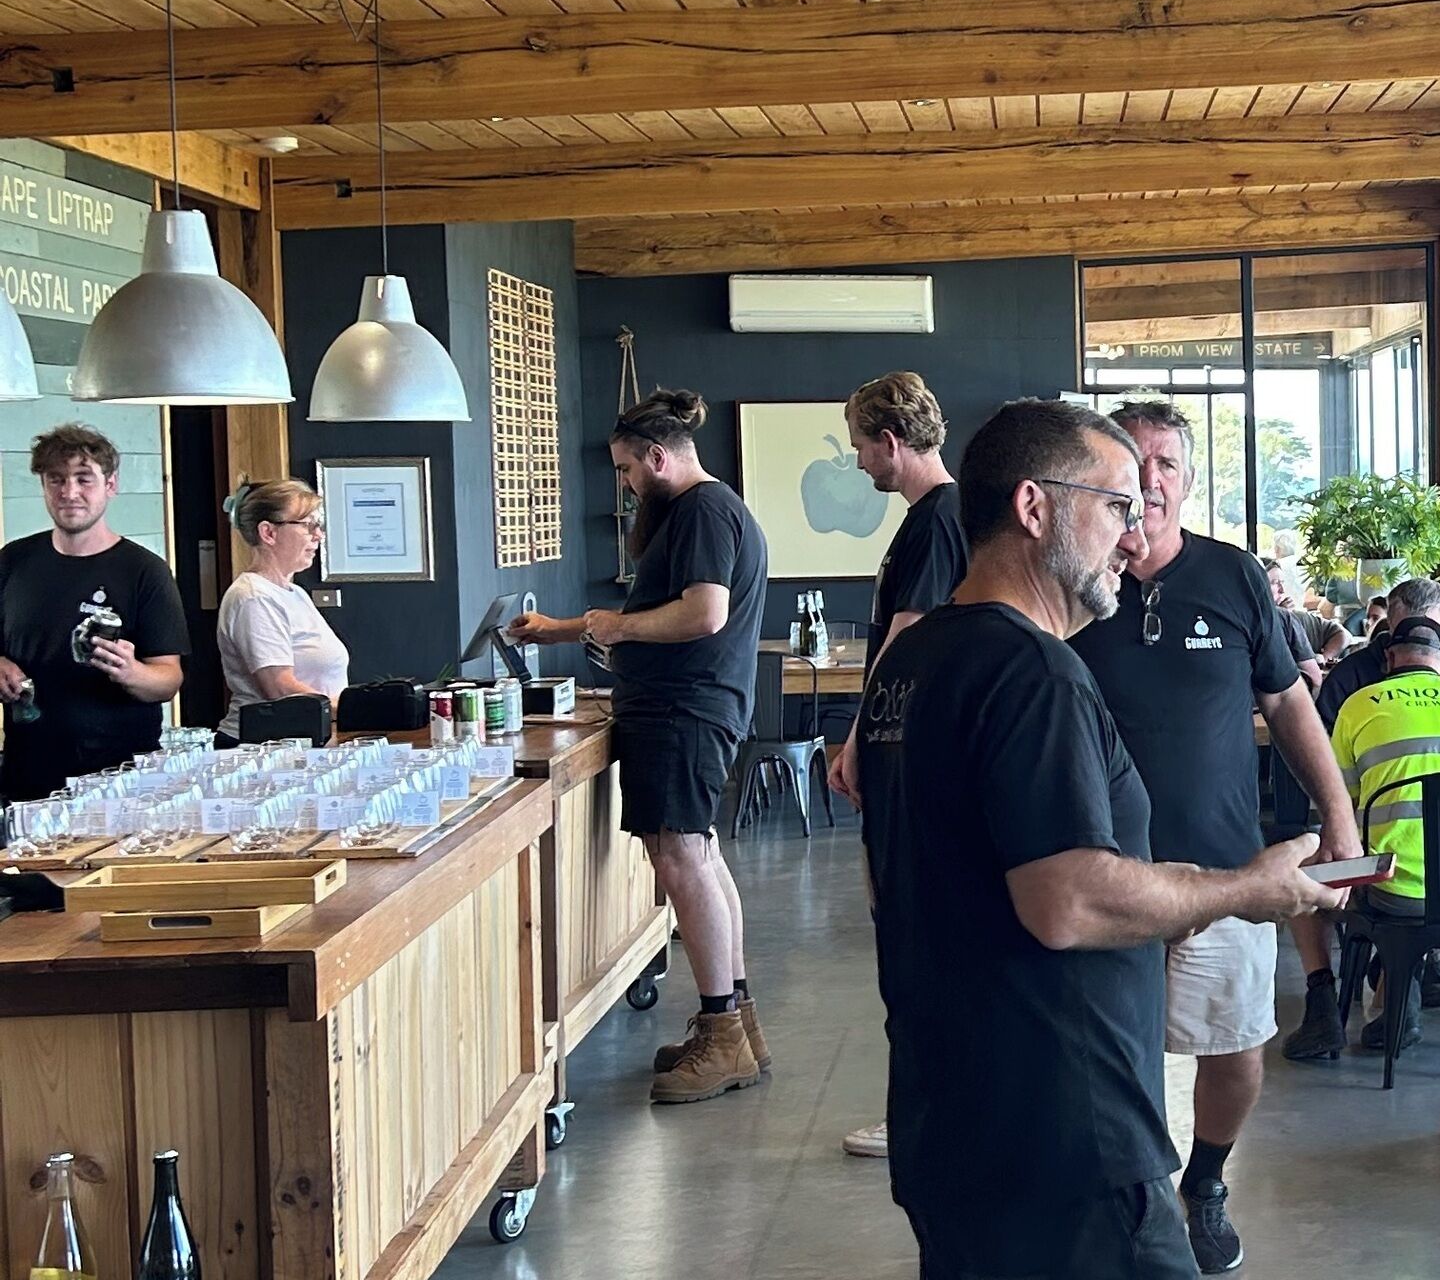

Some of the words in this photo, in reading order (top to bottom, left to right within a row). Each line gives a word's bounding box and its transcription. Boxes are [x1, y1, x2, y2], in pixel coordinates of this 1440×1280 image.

[2, 175, 39, 219] APE
[47, 187, 114, 236] LIPTRAP
[0, 266, 75, 314] OASTAL
[1139, 344, 1184, 358] PROM
[1195, 343, 1234, 357] VIEW
[1254, 342, 1302, 356] STATE
